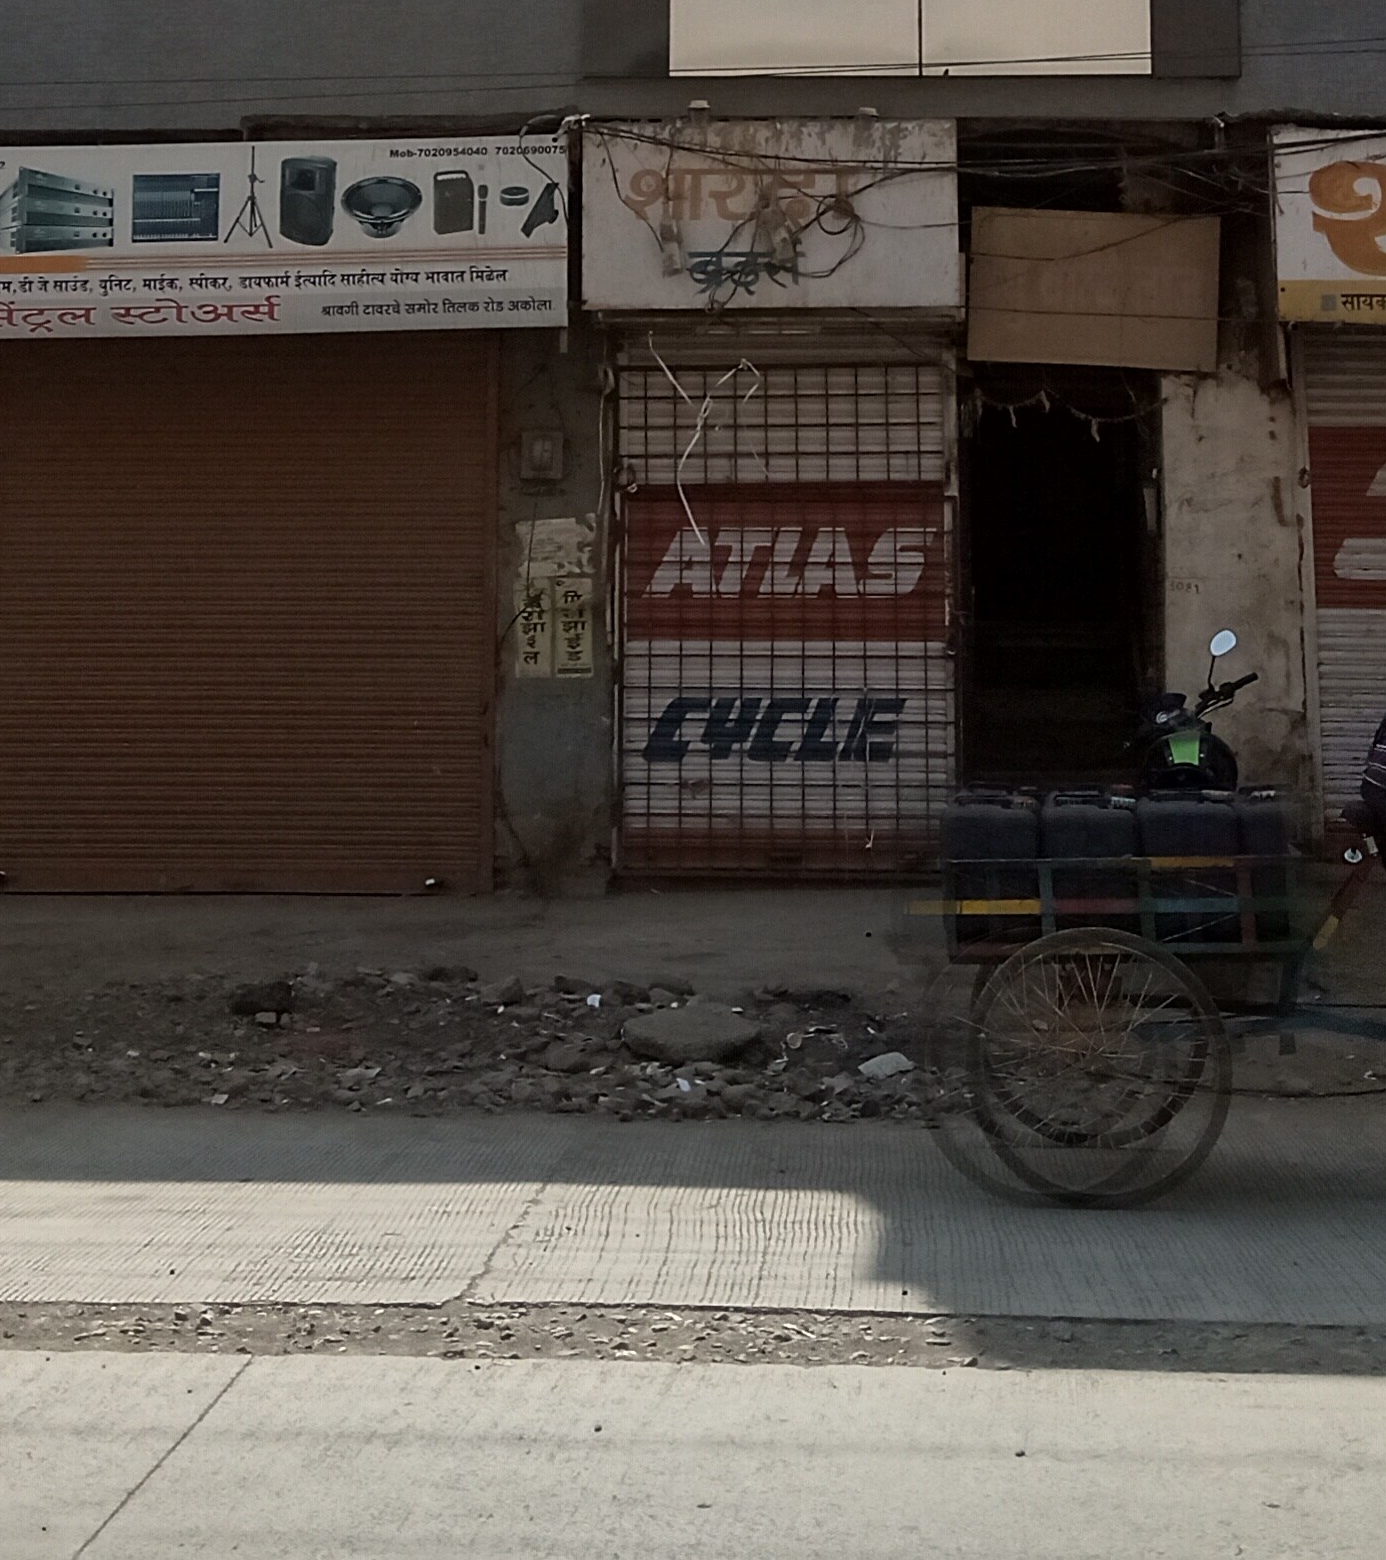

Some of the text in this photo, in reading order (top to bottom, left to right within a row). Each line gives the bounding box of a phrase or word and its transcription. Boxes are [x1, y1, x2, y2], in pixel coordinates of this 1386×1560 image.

[389, 146, 489, 158] Mob-7020954040
[404, 297, 438, 315] समोर
[442, 297, 480, 314] तिलक
[483, 296, 504, 313] रोड
[507, 295, 554, 313] अकोला
[641, 525, 936, 600] ATLAS
[642, 696, 906, 763] CYCLE
